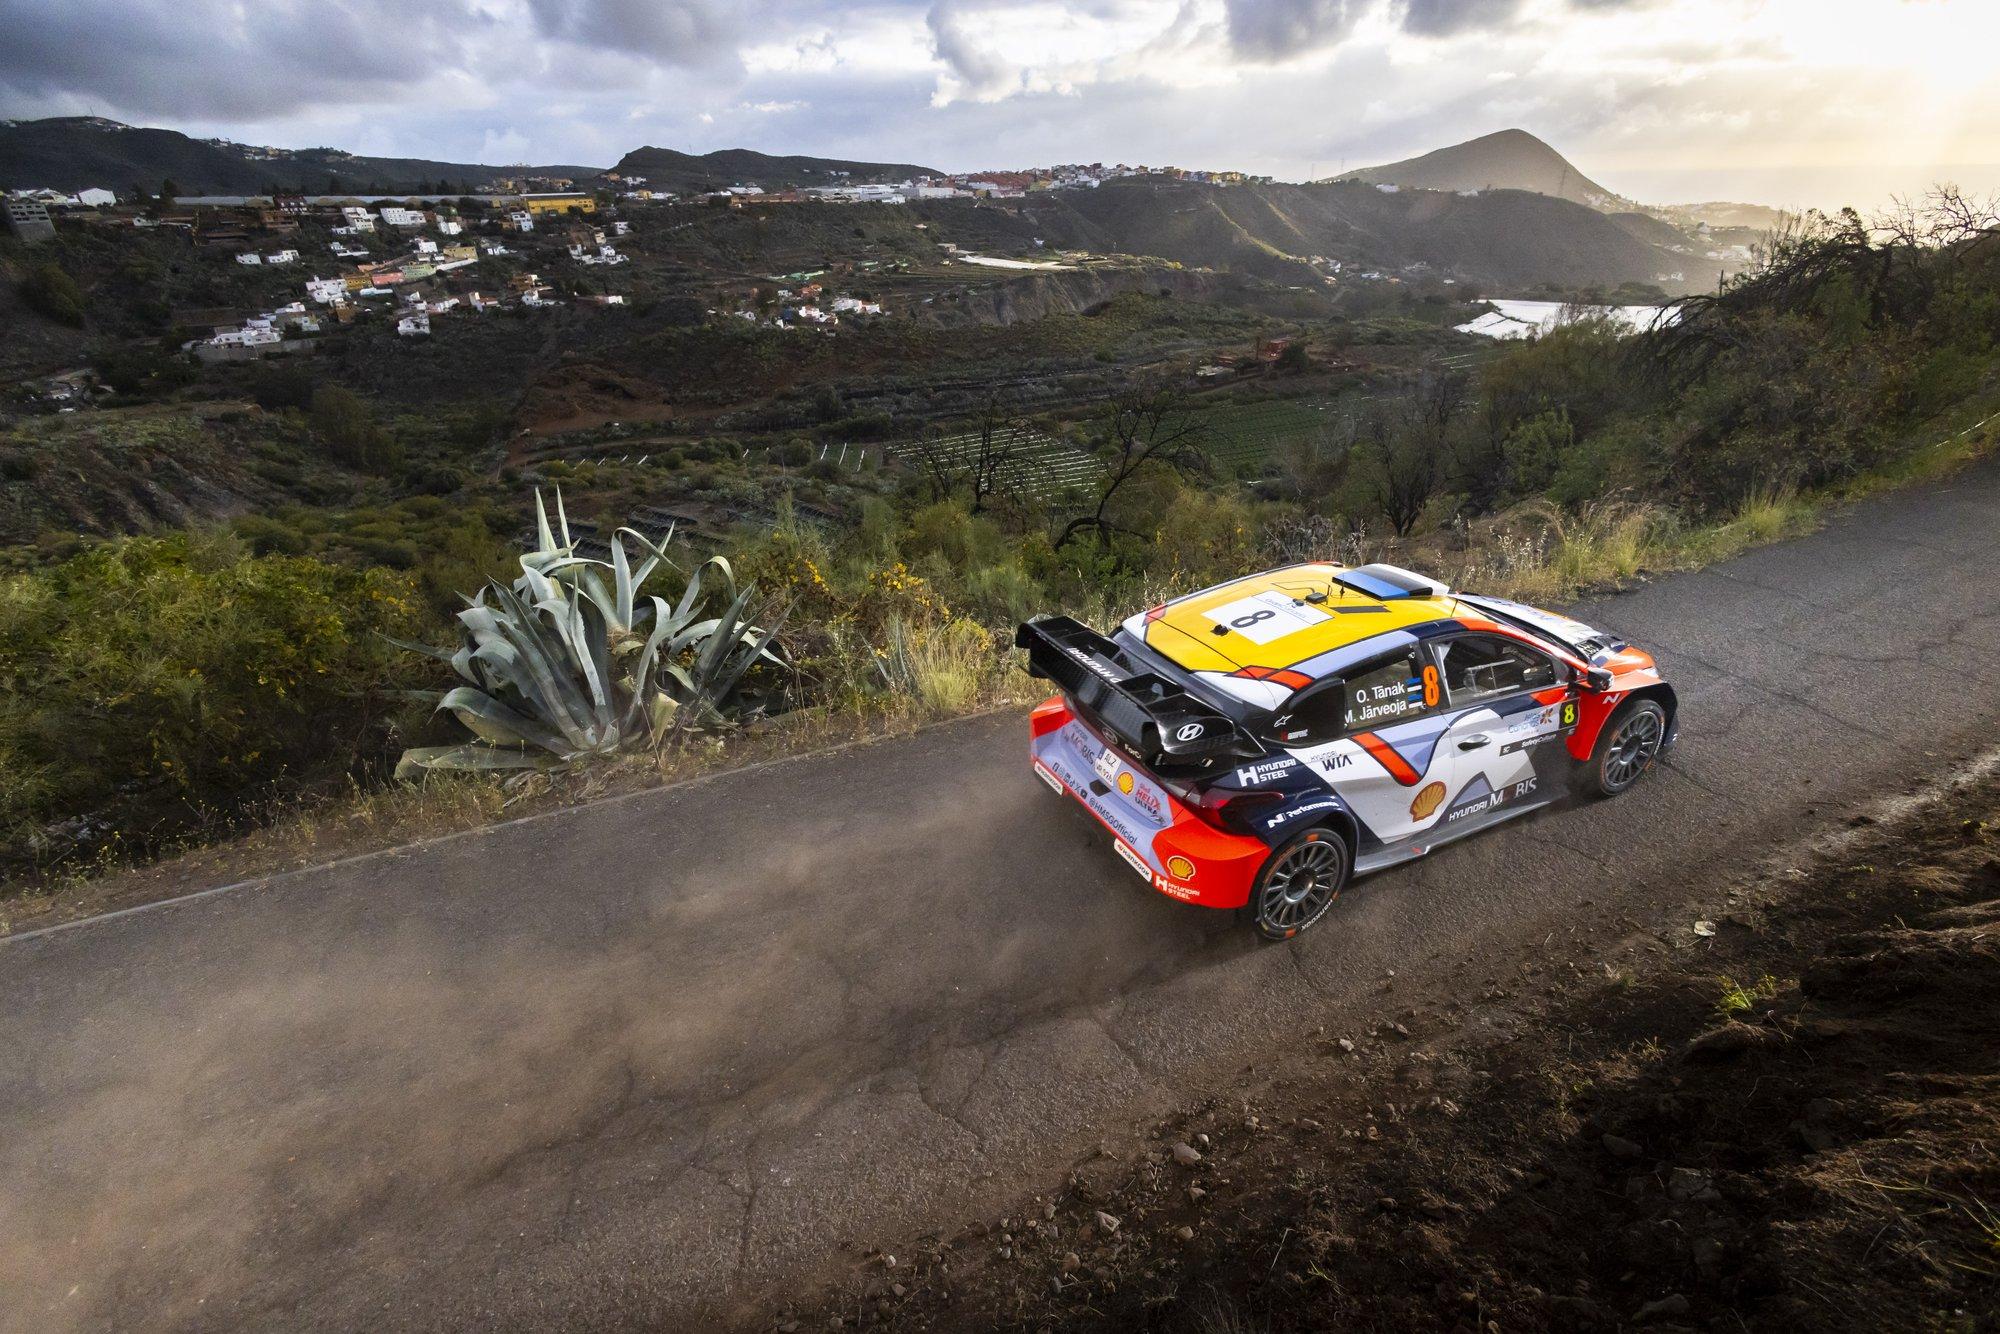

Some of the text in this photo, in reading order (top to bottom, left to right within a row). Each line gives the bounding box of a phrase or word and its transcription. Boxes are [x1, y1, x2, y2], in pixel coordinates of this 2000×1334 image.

[1231, 610, 1276, 628] 8
[1423, 665, 1440, 707] 8
[1356, 690, 1370, 704] O.
[1563, 704, 1575, 724] 8
[1257, 758, 1297, 773] HYUNDAI
[1260, 769, 1289, 782] STEEL
[1449, 777, 1537, 821] HYUNDAI MBIS
[1089, 797, 1138, 845] @HMSGOfficial
